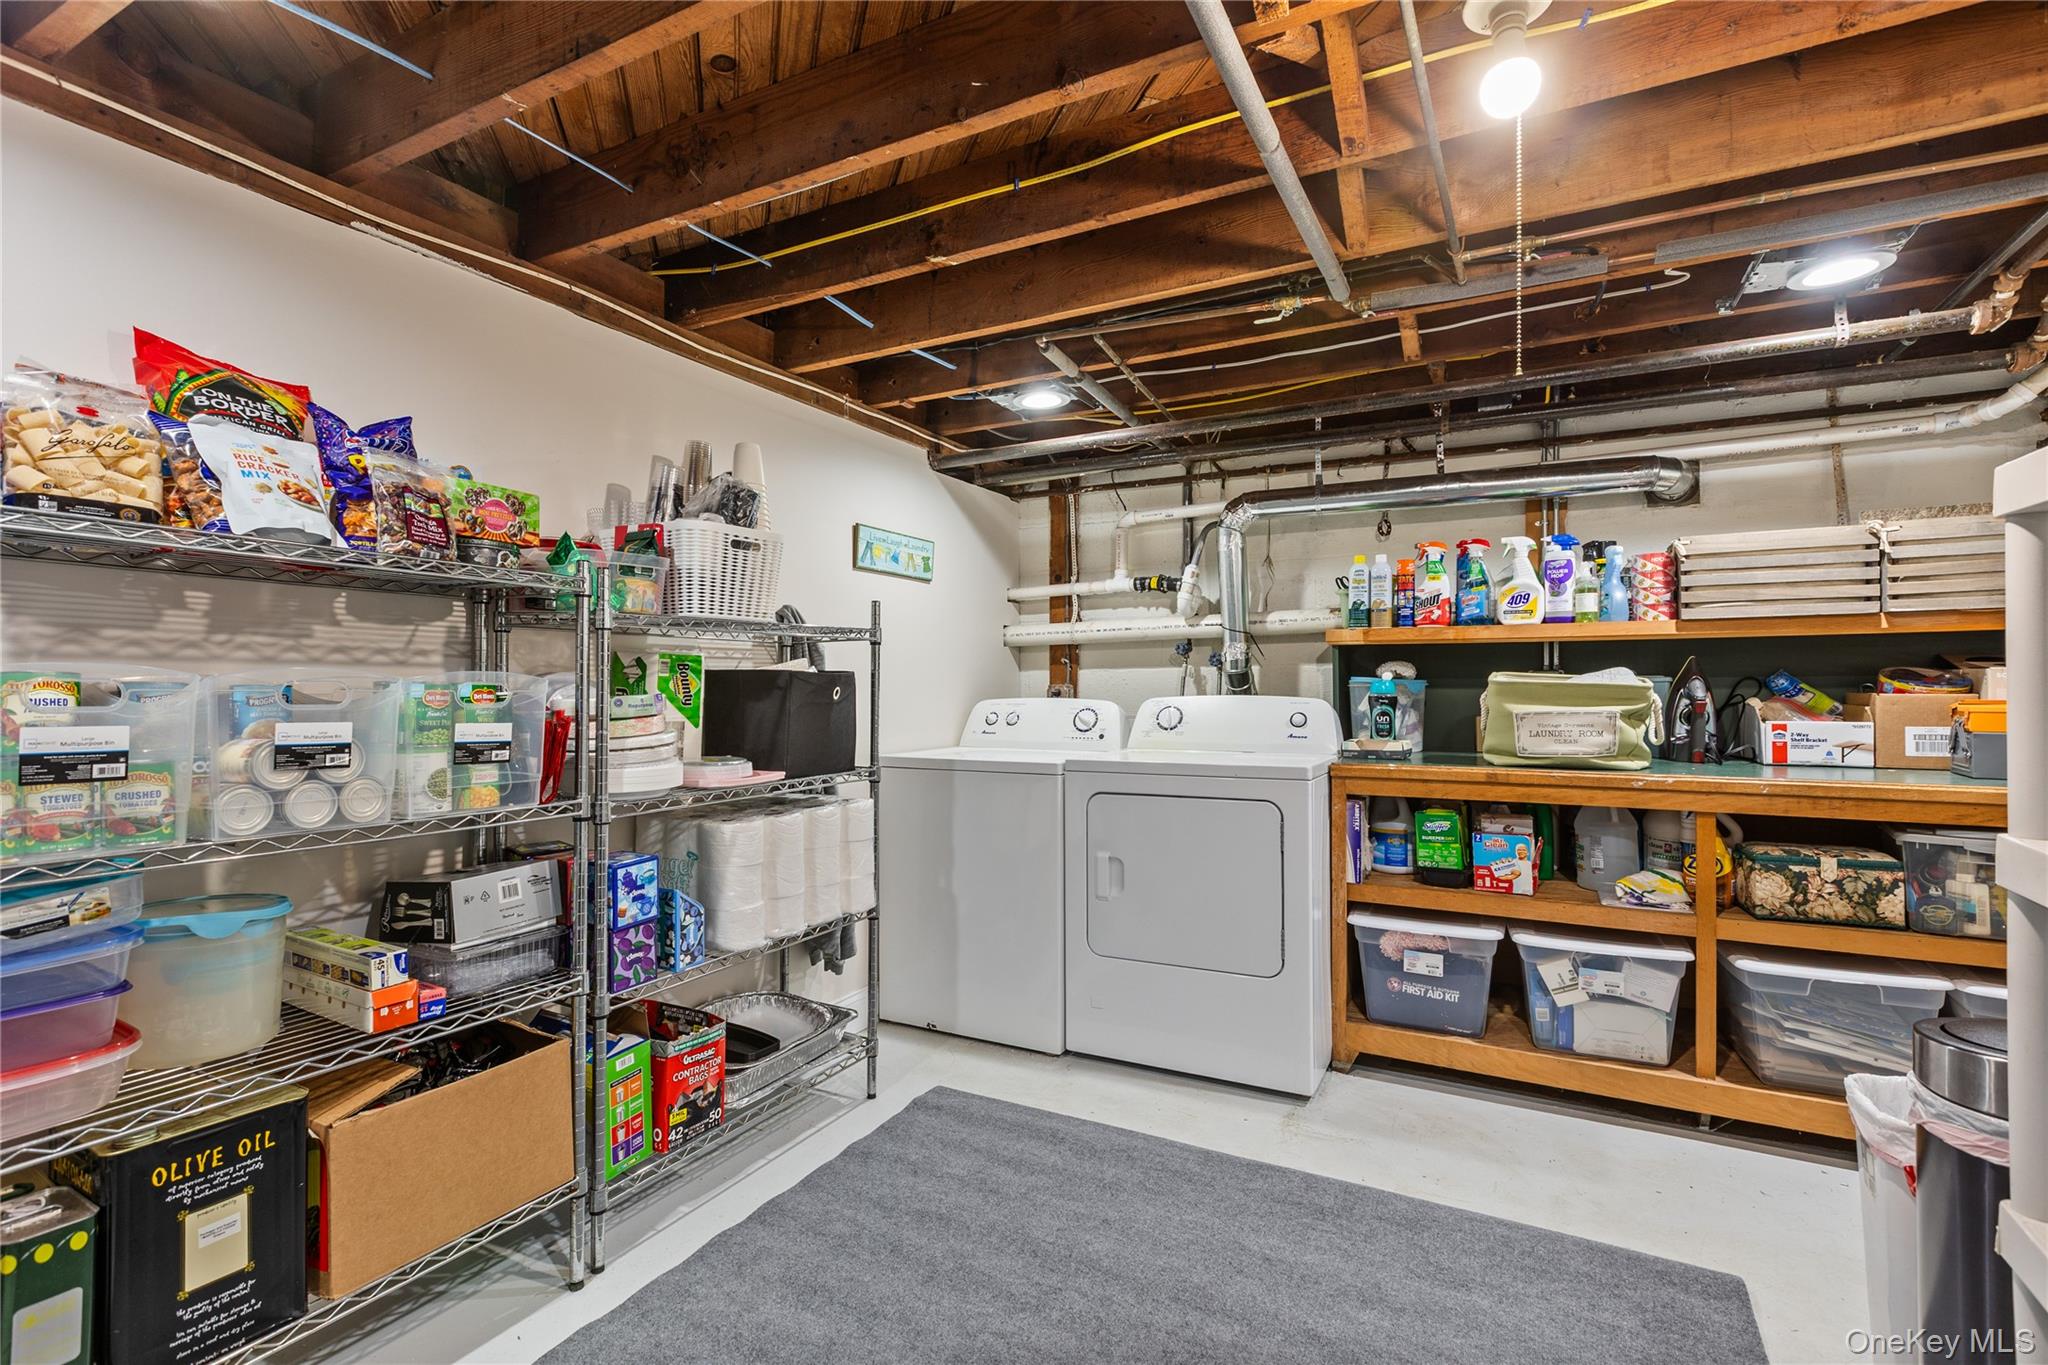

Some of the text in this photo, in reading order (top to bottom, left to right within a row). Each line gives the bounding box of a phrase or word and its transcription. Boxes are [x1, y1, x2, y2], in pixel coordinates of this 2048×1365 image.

[201, 388, 275, 411] ON THE
[193, 396, 293, 432] BORDER
[213, 414, 286, 437] EXICAN GRILL
[41, 428, 136, 453] Garofalo
[233, 453, 266, 464] RICE
[237, 461, 301, 481] CRACKER
[240, 470, 271, 480] MIX
[1415, 593, 1443, 610] SHOUT
[1507, 592, 1531, 606] 409
[676, 662, 694, 707] Bounty
[29, 697, 69, 708] USHED
[1528, 729, 1604, 738] LAUNDRY ROOM
[40, 793, 84, 805] STEWED
[114, 789, 162, 801] CRUSHED
[42, 804, 82, 812] TOMATOES
[118, 800, 158, 809] TOMATOES
[1484, 841, 1508, 849] Clean
[376, 959, 385, 971] 45
[1402, 985, 1460, 1003] FIRST AID KIT
[672, 1056, 722, 1082] CONTRACTOR
[688, 1071, 709, 1085] BAGS
[708, 1107, 722, 1123] 50
[668, 1126, 684, 1141] 42
[151, 1130, 276, 1187] OLIVE OIL
